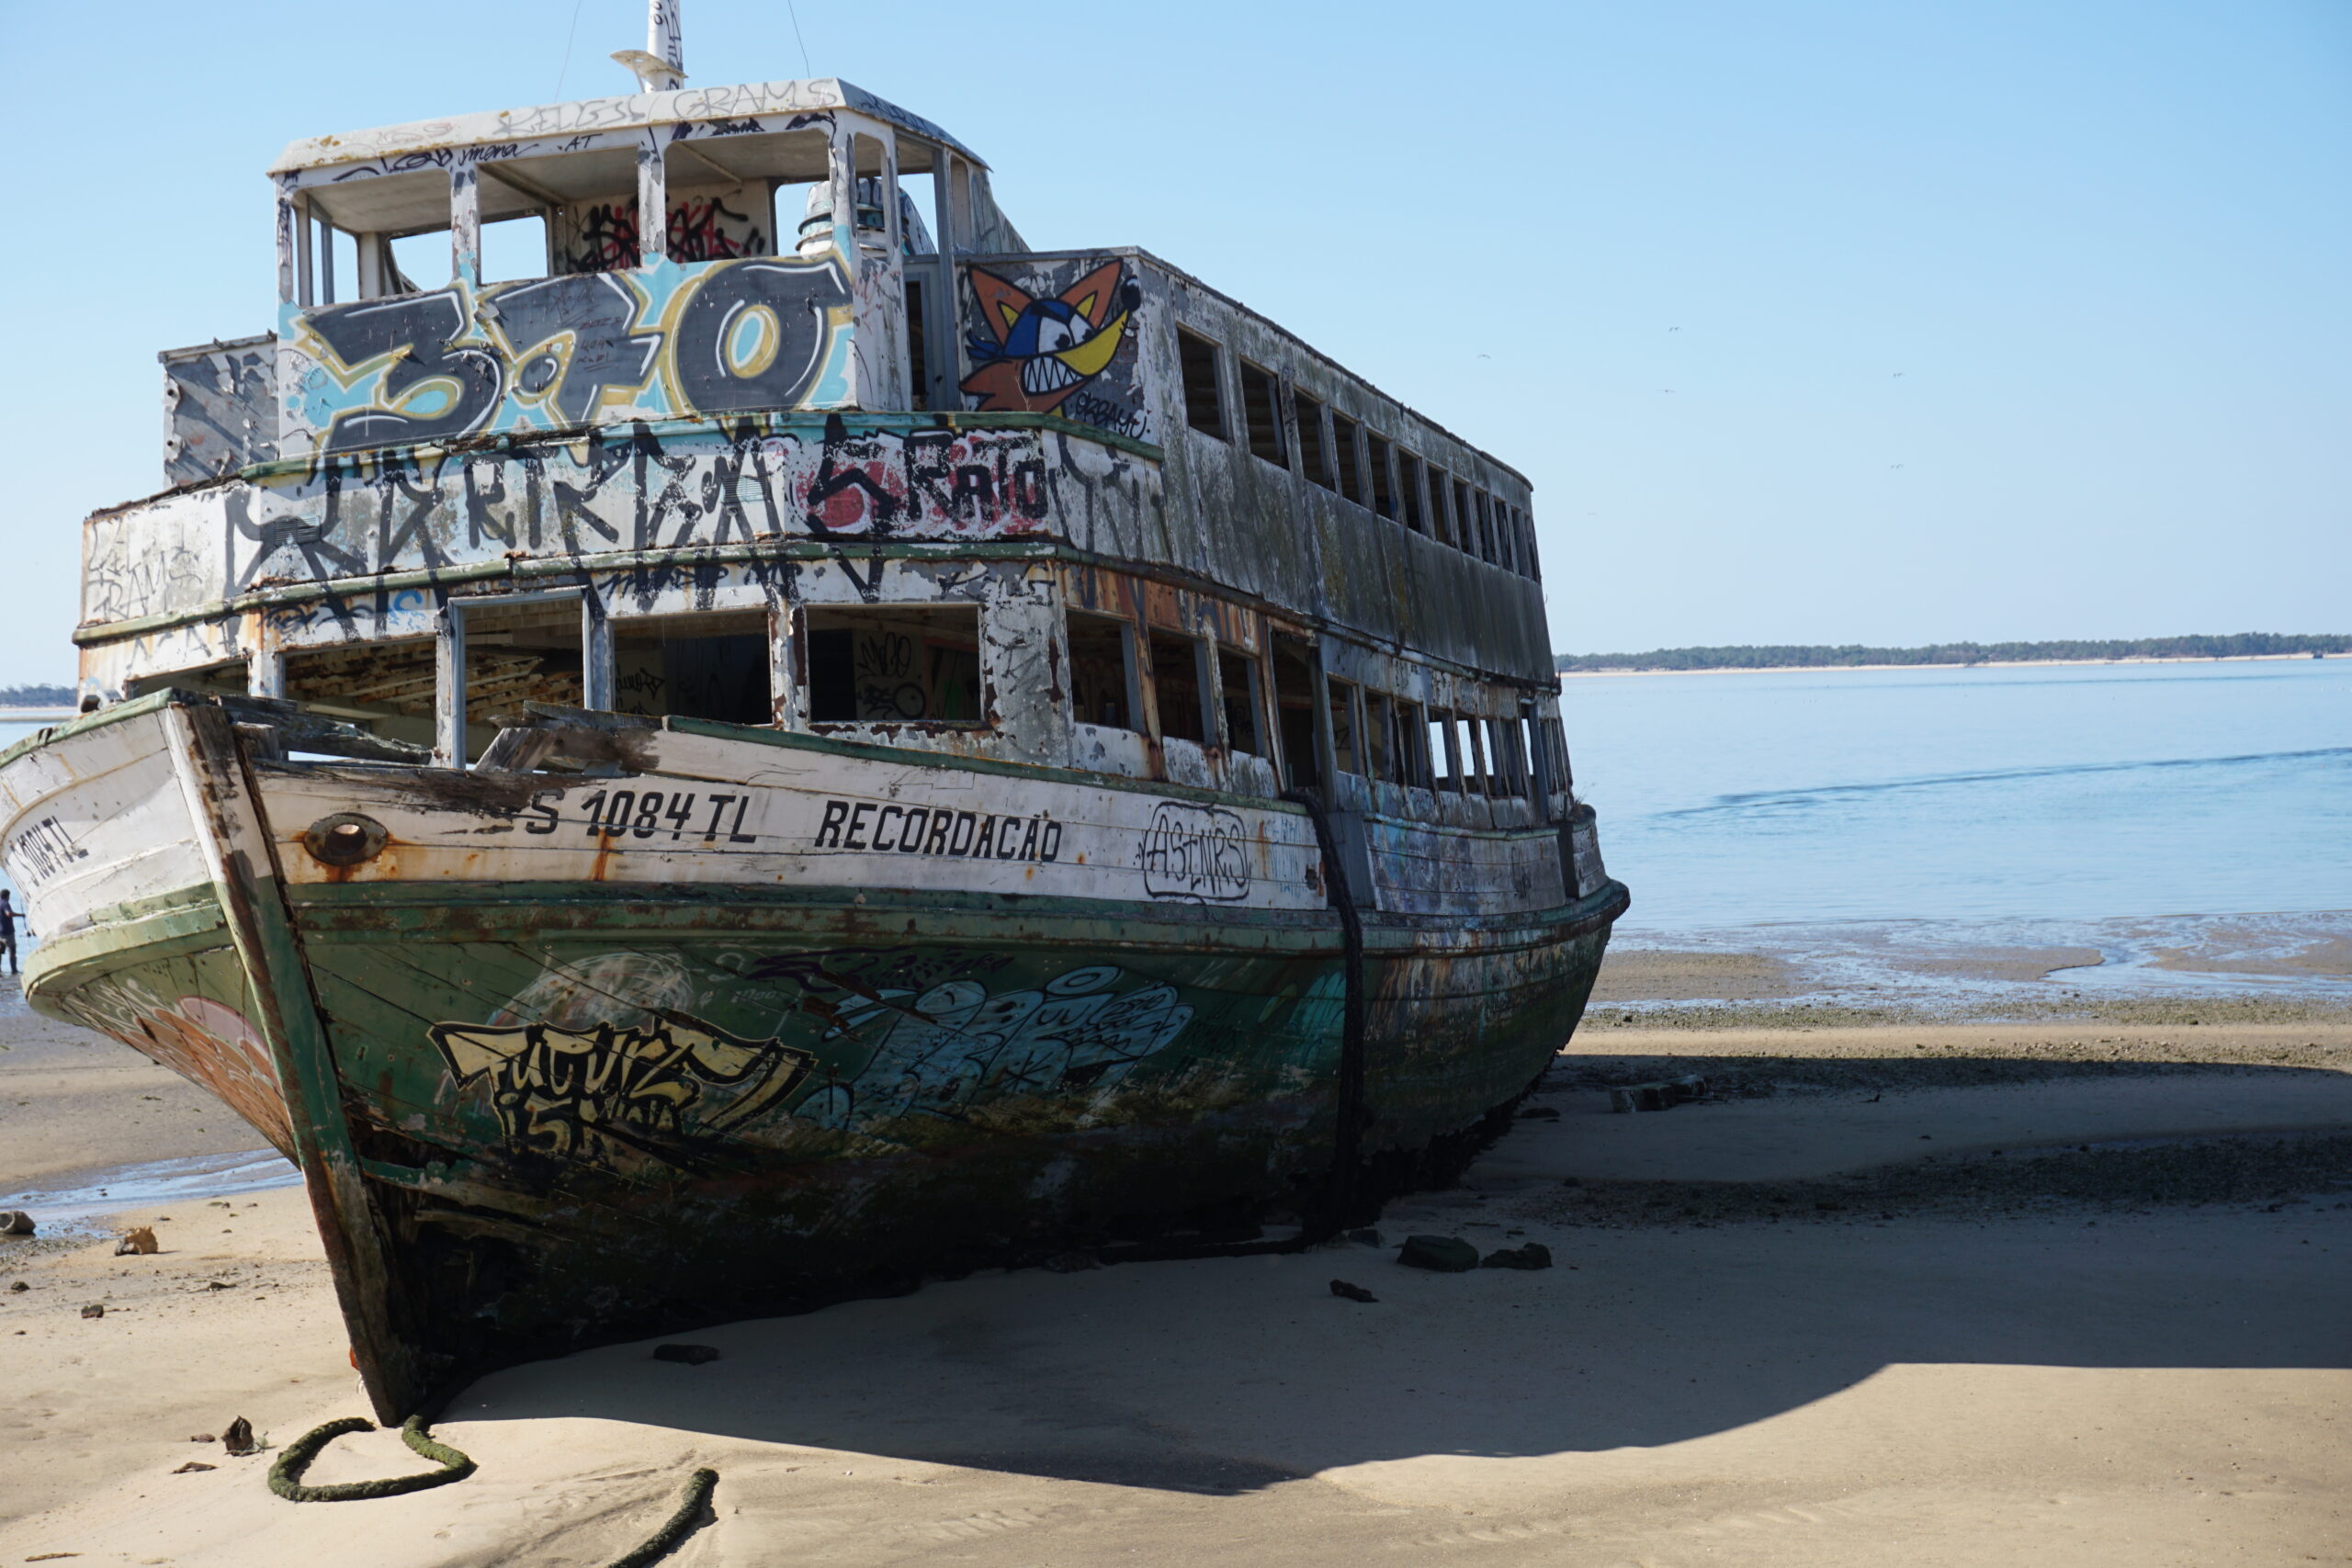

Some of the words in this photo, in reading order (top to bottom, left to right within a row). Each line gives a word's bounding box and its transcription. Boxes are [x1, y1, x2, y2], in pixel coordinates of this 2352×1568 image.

[526, 788, 565, 834] S
[581, 789, 695, 840] 1084
[704, 794, 757, 843] TL
